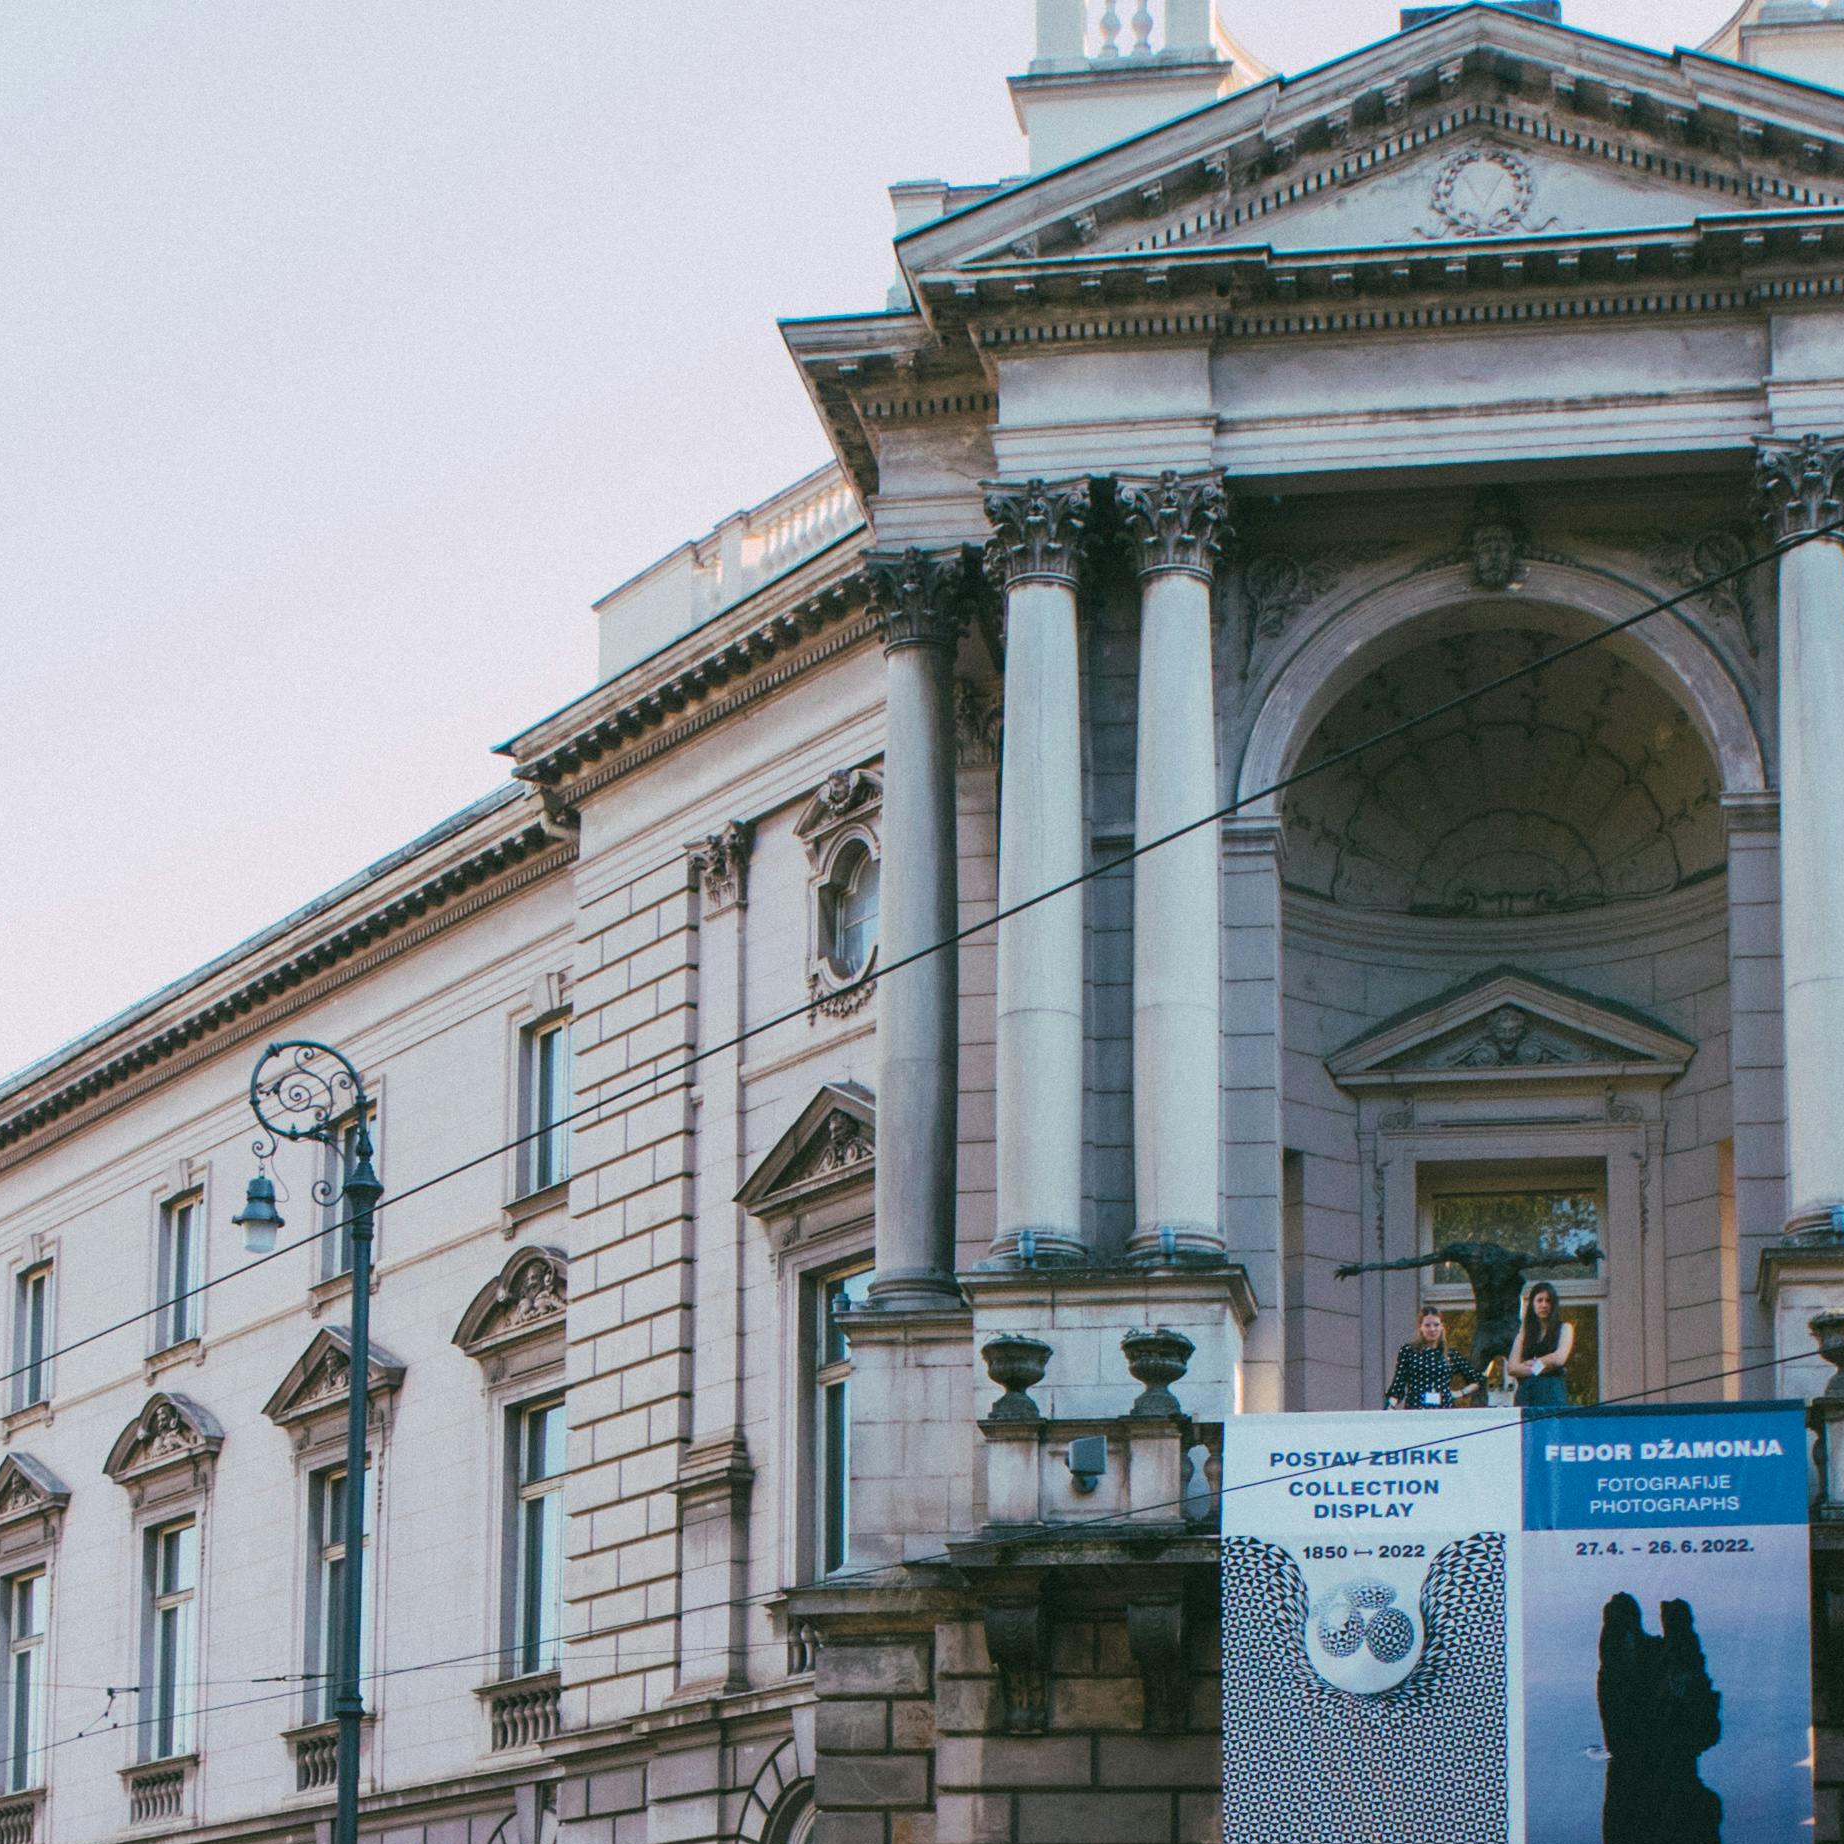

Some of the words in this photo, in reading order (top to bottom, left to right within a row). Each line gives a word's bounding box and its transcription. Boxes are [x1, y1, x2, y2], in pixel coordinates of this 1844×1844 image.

[1270, 1452, 1359, 1467] POSTAV
[1369, 1449, 1459, 1465] ZBIRKE
[1544, 1443, 1632, 1463] FEDOR
[1640, 1438, 1784, 1460] DŽAMONJA
[1289, 1480, 1439, 1496] COLLECTION
[1597, 1474, 1732, 1492] FOTOGRAFIJE
[1314, 1502, 1414, 1519] DISPLAY
[1590, 1496, 1741, 1514] PHOTOGRAPHS
[1303, 1546, 1348, 1559] 1850
[1378, 1544, 1426, 1558] 2022
